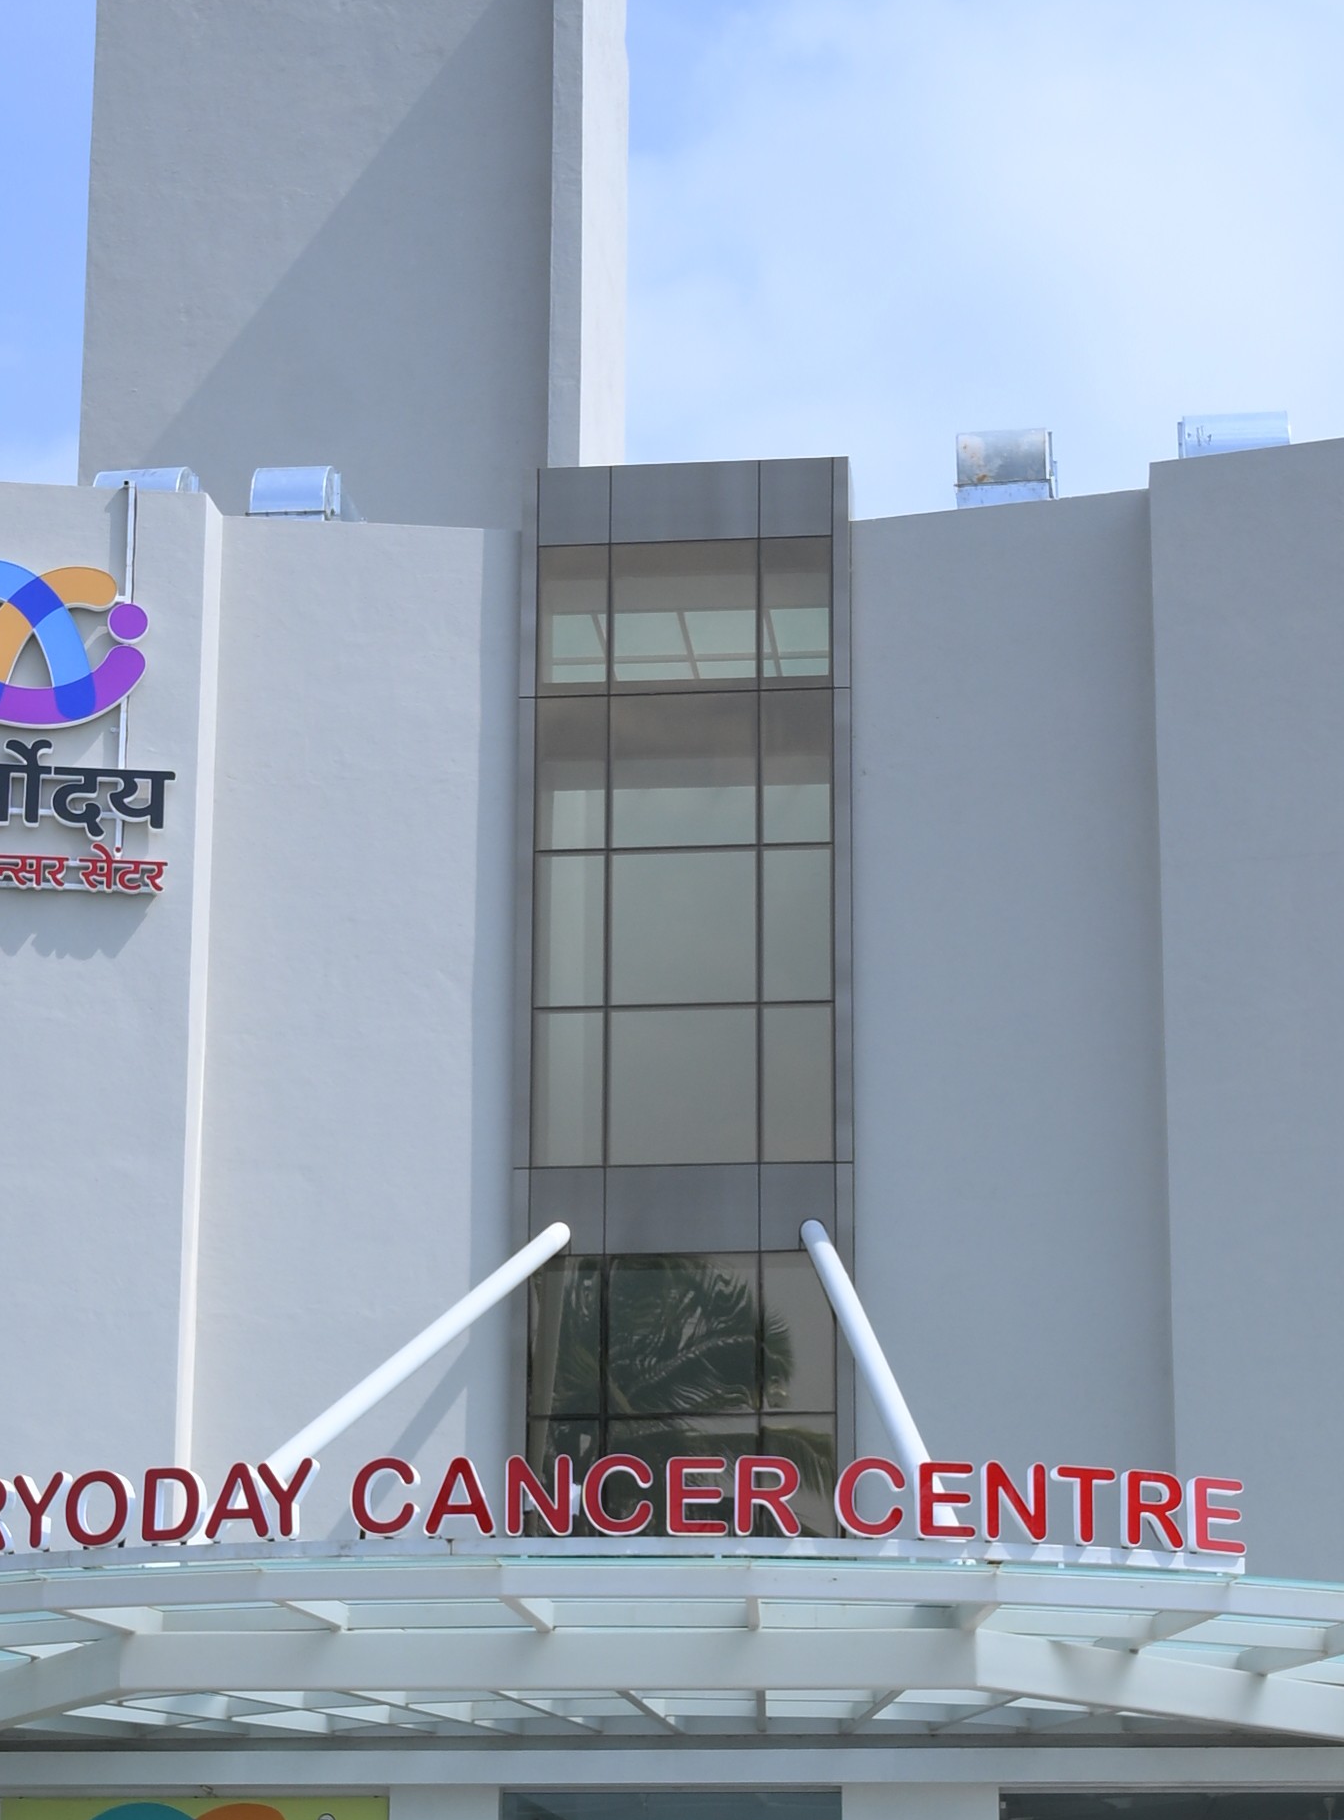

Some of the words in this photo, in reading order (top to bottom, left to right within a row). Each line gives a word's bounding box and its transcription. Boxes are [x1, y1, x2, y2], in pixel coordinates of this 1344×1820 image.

[78, 843, 168, 891] सेंटर
[351, 1454, 801, 1537] CANCER
[833, 1456, 1246, 1556] CENTRE
